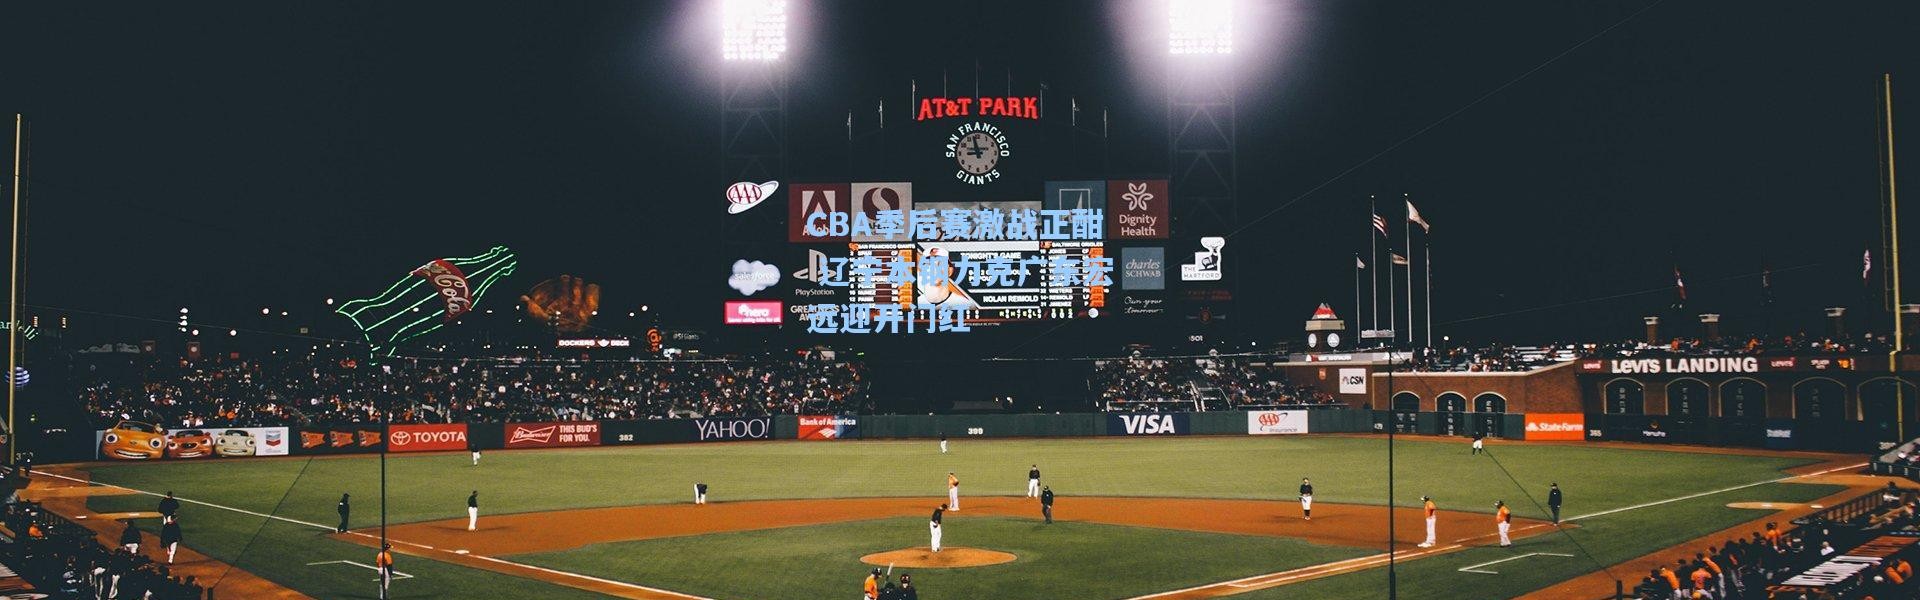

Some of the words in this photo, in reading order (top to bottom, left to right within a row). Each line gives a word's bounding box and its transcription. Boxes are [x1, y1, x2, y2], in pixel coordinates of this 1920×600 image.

[917, 97, 972, 121] AT&T
[979, 97, 1038, 120] PARK
[946, 133, 960, 158] SAN
[958, 121, 1010, 157] FRANCISCO
[956, 169, 1000, 185] GIANTS
[1119, 214, 1157, 227] Dignity
[1121, 227, 1156, 236] Health
[1125, 258, 1160, 270] charles
[1125, 270, 1161, 278] SCHWAB
[795, 289, 835, 297] PlayStation
[1142, 299, 1163, 309] your
[558, 339, 595, 347] DOCKERS
[1666, 357, 1758, 373] LANDING
[1350, 376, 1364, 385] CSN
[559, 425, 576, 433] THIS
[576, 424, 598, 433] BUD'S
[696, 418, 770, 441] YAHOO!
[1119, 415, 1176, 434] VISA
[413, 430, 467, 443] TOYOTA
[559, 434, 574, 443] FOR
